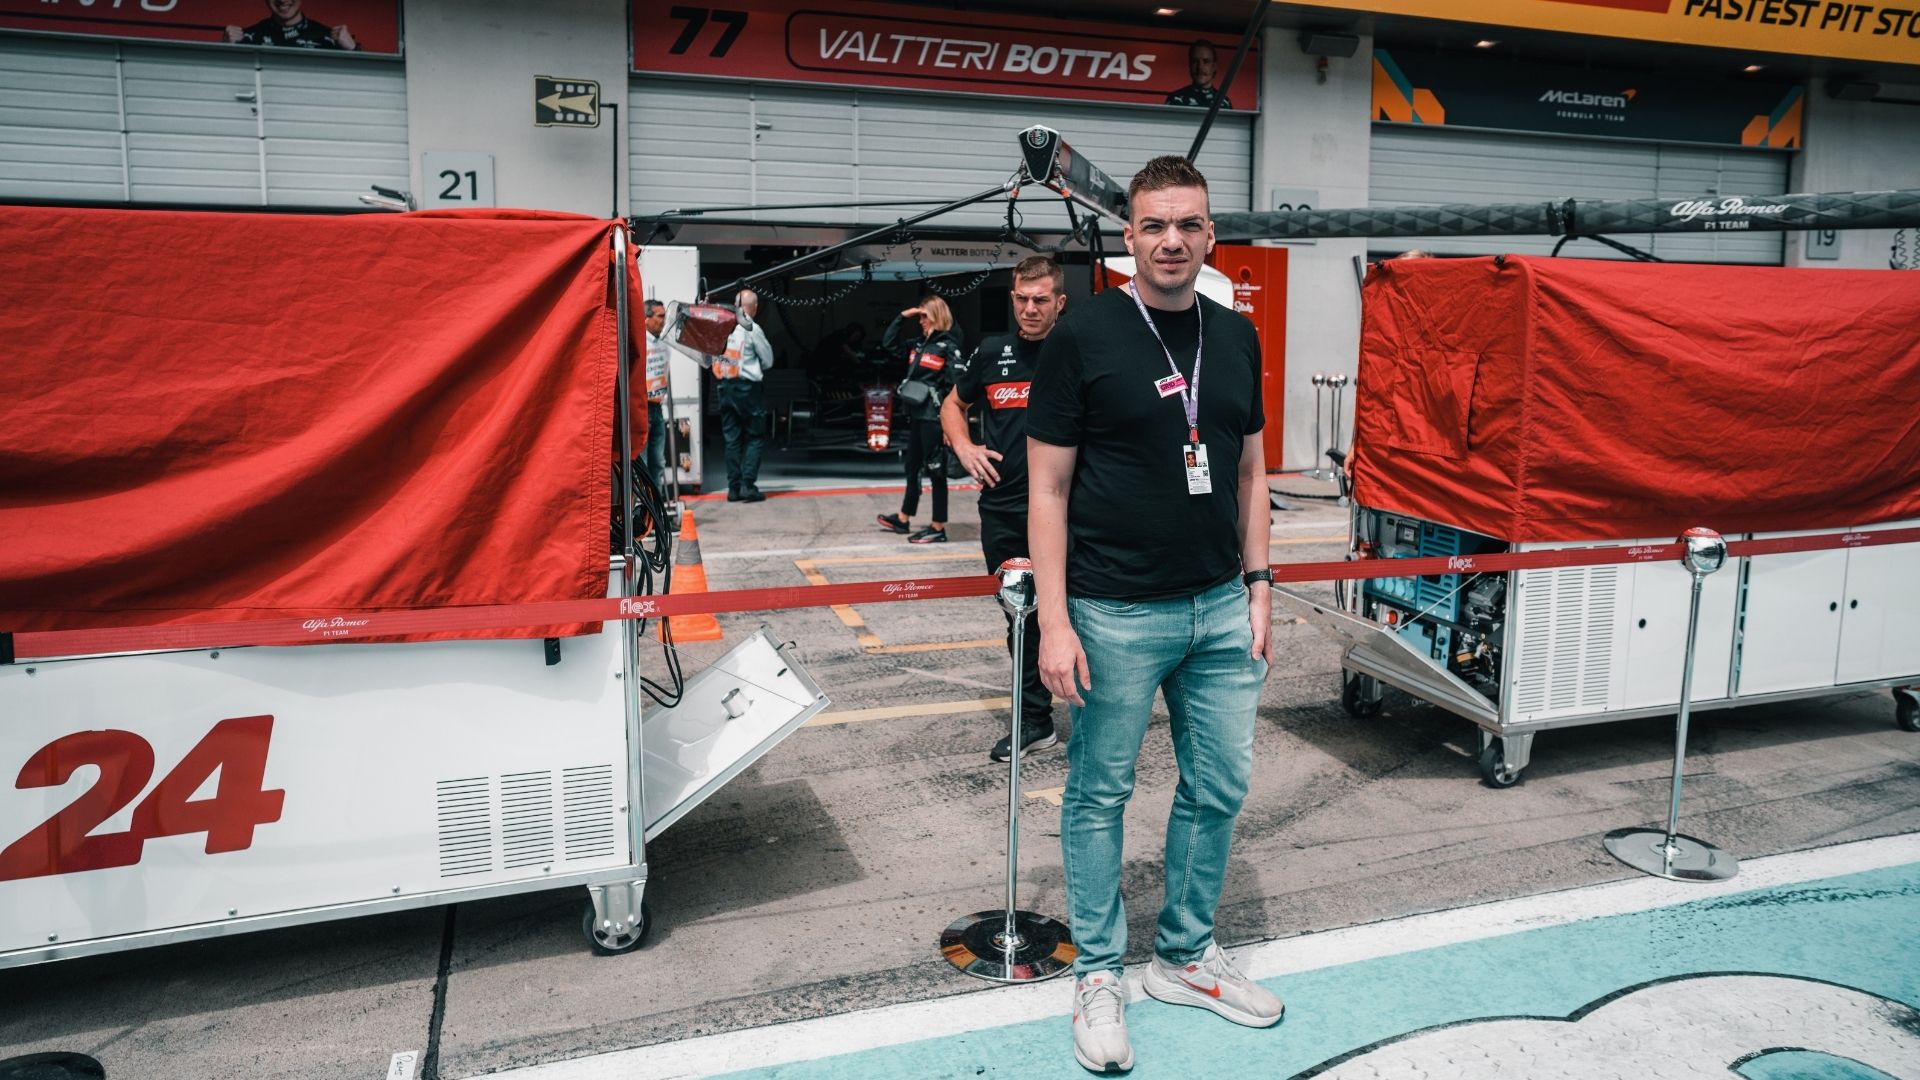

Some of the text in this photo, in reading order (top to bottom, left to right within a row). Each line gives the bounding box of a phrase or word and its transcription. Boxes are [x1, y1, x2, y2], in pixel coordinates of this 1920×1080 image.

[1684, 0, 1820, 27] FASTEST
[1820, 2, 1873, 33] PIT
[669, 6, 748, 58] 77
[819, 28, 1156, 81] VALTTERI BOTTAS
[1539, 89, 1626, 108] McLaren
[439, 169, 478, 201] 21
[1670, 198, 1790, 222] Alfa Romeo
[1704, 221, 1749, 230] F1 TEAM
[1815, 230, 1836, 246] 19
[930, 247, 968, 257] VALTTERI
[1448, 555, 1472, 571] flex
[883, 581, 934, 595] Alfa Romeo
[620, 598, 655, 616] flex
[302, 616, 370, 632] Alfa Romeo
[0, 714, 286, 882] 24
